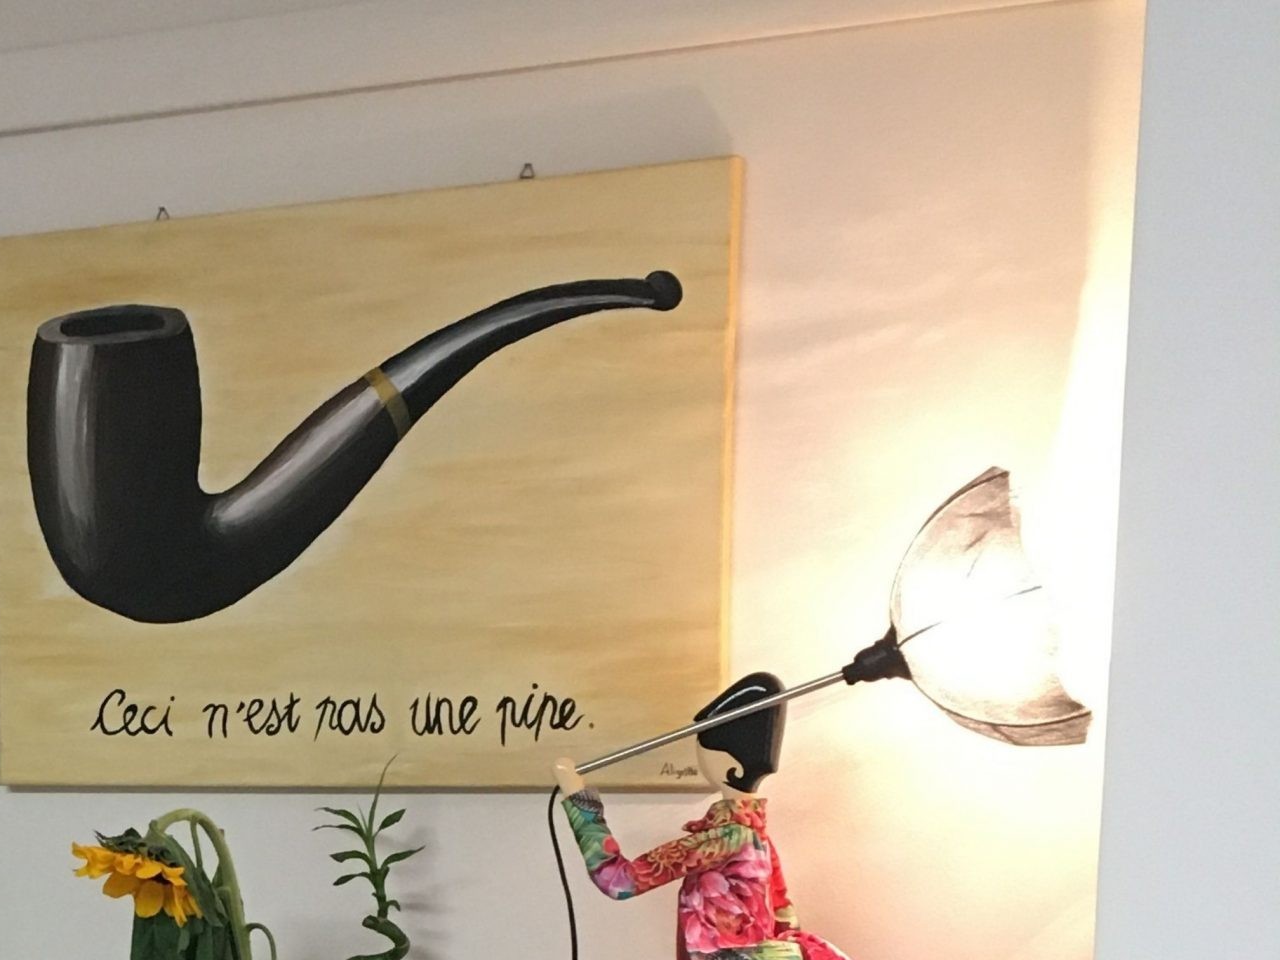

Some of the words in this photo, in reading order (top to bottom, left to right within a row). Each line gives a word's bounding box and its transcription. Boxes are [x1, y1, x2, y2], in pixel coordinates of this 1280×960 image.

[90, 688, 176, 738] Ceci
[202, 691, 302, 739] n'est
[314, 691, 386, 743] pas
[409, 691, 482, 737] une
